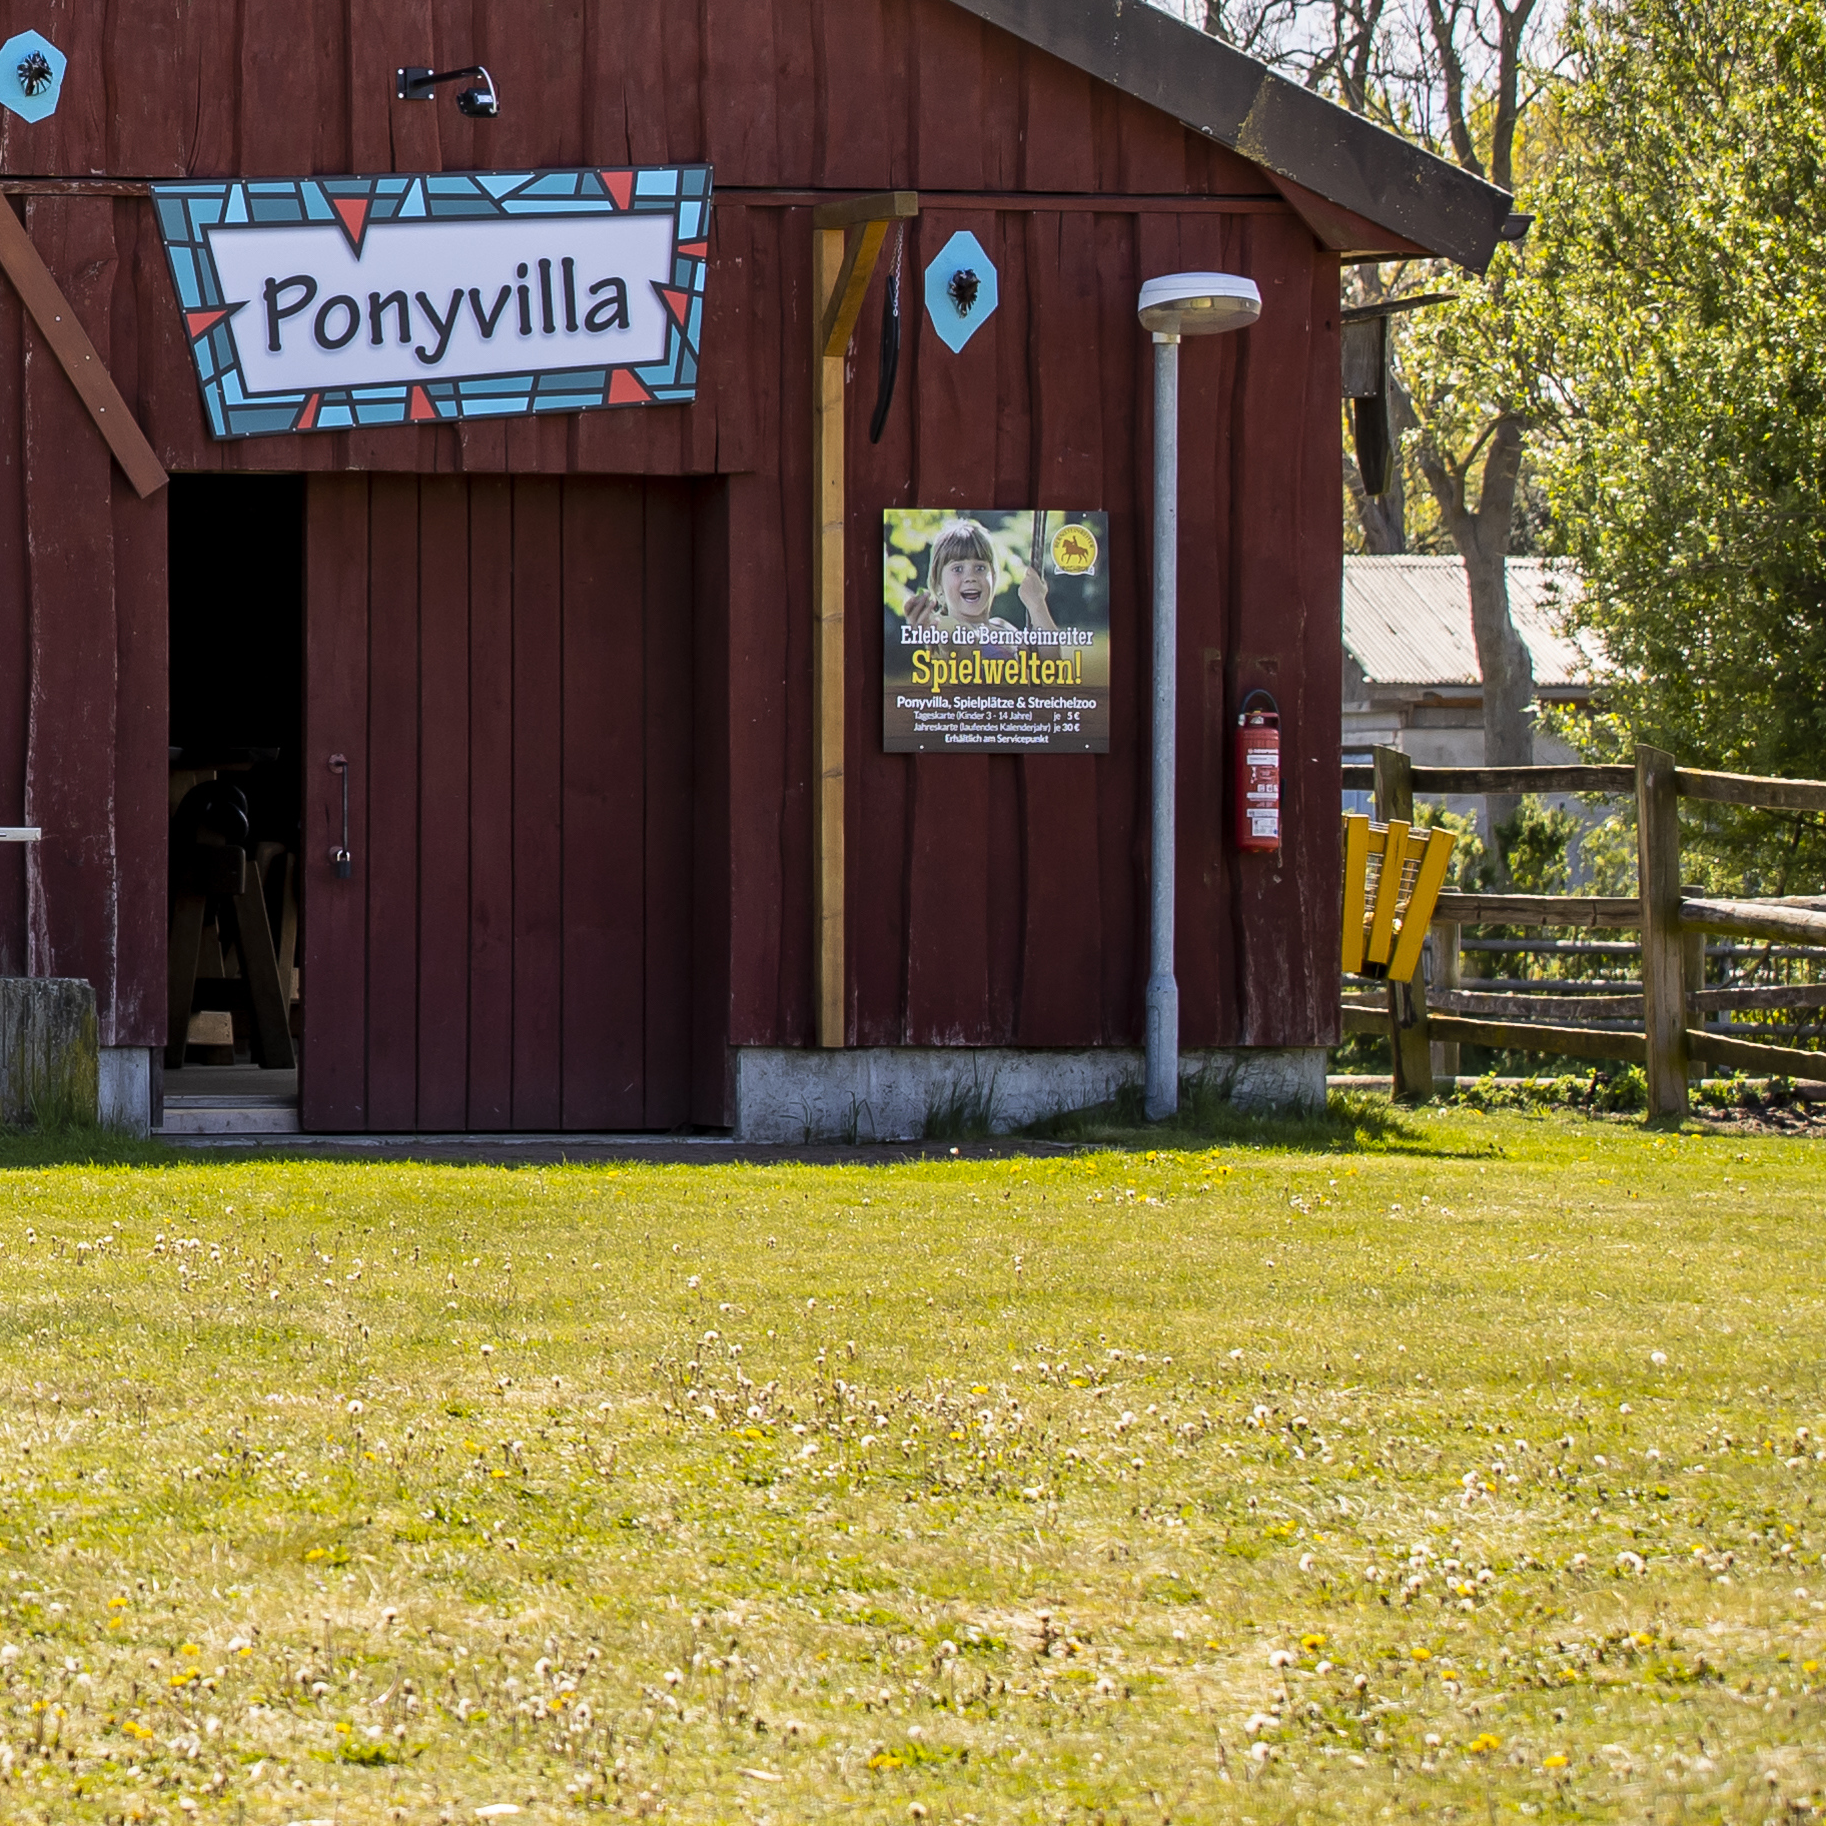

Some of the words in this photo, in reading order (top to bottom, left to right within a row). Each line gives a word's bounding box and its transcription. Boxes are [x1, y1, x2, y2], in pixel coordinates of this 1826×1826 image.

[262, 256, 630, 364] Ponyvilla
[900, 625, 948, 645] Erlebe
[952, 625, 975, 645] die
[979, 626, 1094, 645] Bernsteinreiter
[911, 649, 1082, 693] Spielwelten!
[896, 695, 952, 710] Ponyvilla,
[953, 696, 1014, 710] Spielplätze
[1016, 697, 1026, 709] &
[1028, 696, 1096, 709] Streichelzoo
[913, 710, 955, 721] Tageskarte
[956, 711, 984, 720] (Kinder
[986, 711, 992, 720] 3
[998, 711, 1008, 720] 14
[1009, 711, 1033, 721] Jahre)
[1053, 711, 1061, 722] je
[1067, 712, 1072, 720] 5
[1074, 711, 1080, 720] €
[913, 722, 958, 731] Jahreskarte
[960, 722, 998, 732] (laufendes
[1000, 723, 1051, 733] Kalenderjahr)
[1053, 723, 1061, 733] je
[1062, 723, 1073, 732] 30
[1074, 723, 1080, 732] €
[945, 733, 982, 743] Erhältlich
[997, 734, 1049, 744] Servicepunkt
